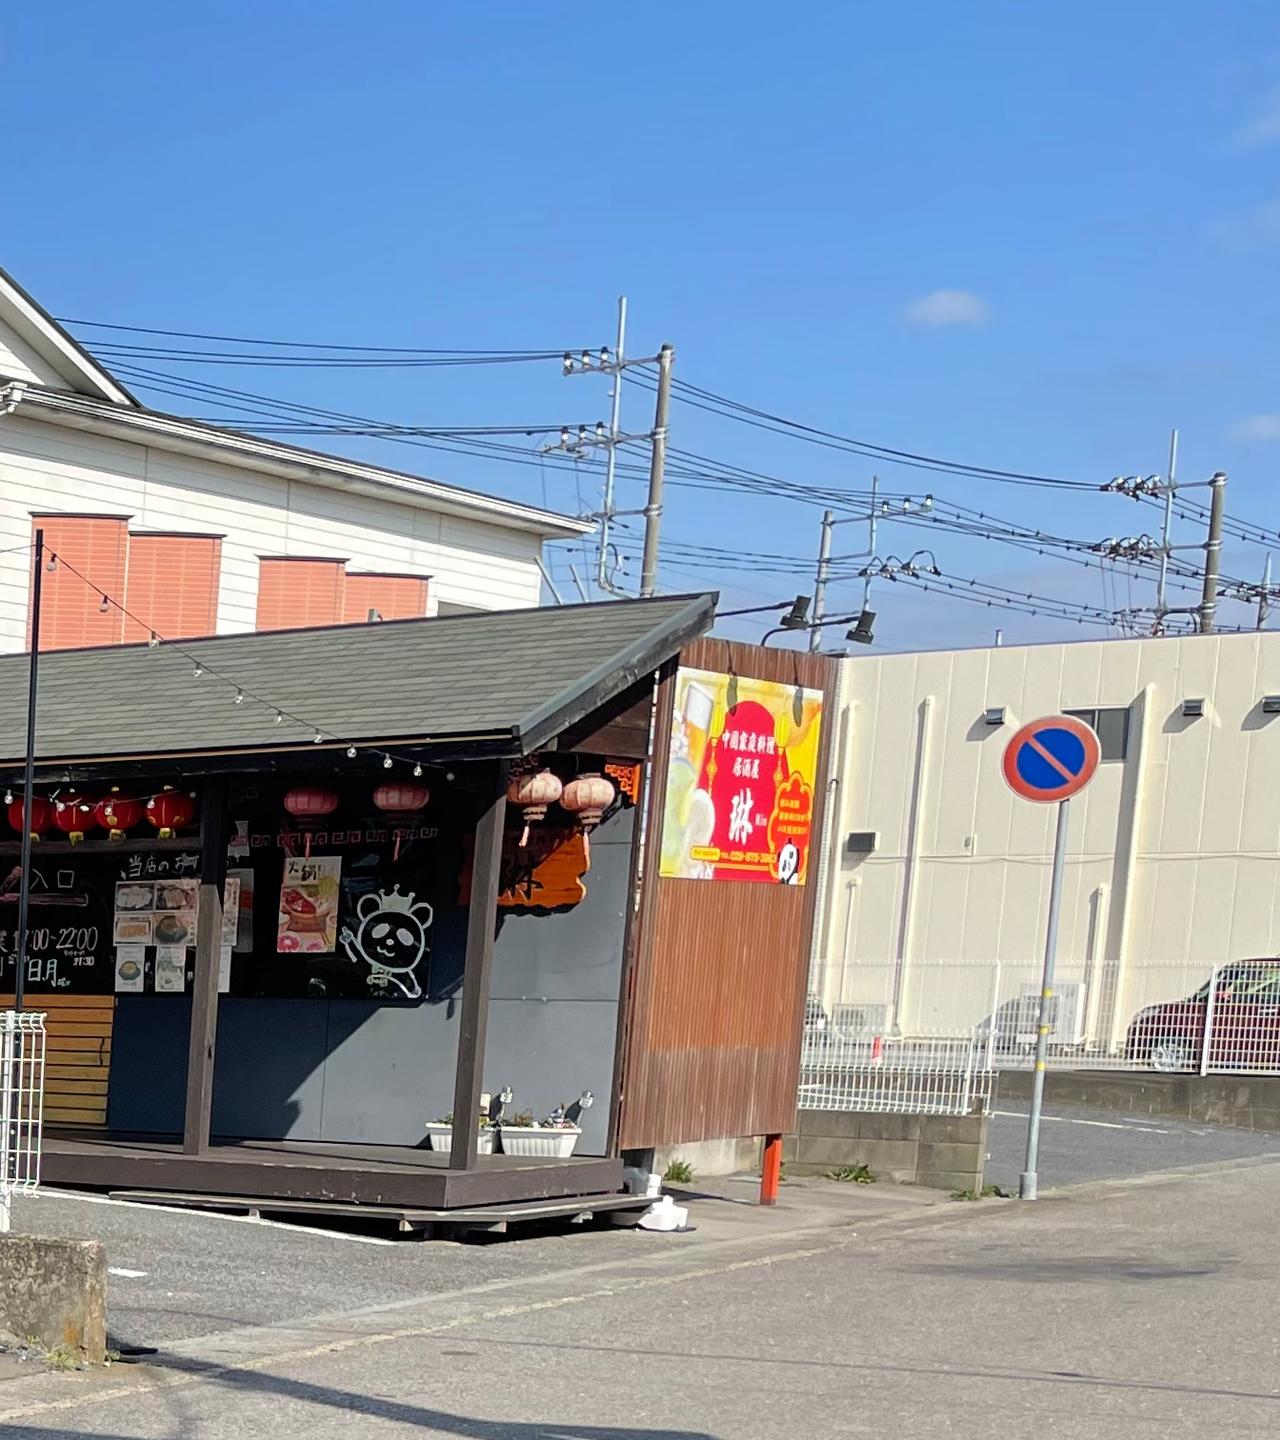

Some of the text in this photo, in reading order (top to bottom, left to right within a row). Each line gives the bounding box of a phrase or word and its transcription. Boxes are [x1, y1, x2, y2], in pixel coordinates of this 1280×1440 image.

[721, 729, 776, 756] 中国家庭料理
[732, 757, 760, 779] 居酒屋
[728, 787, 754, 846] 琳
[30, 868, 75, 889] 入口
